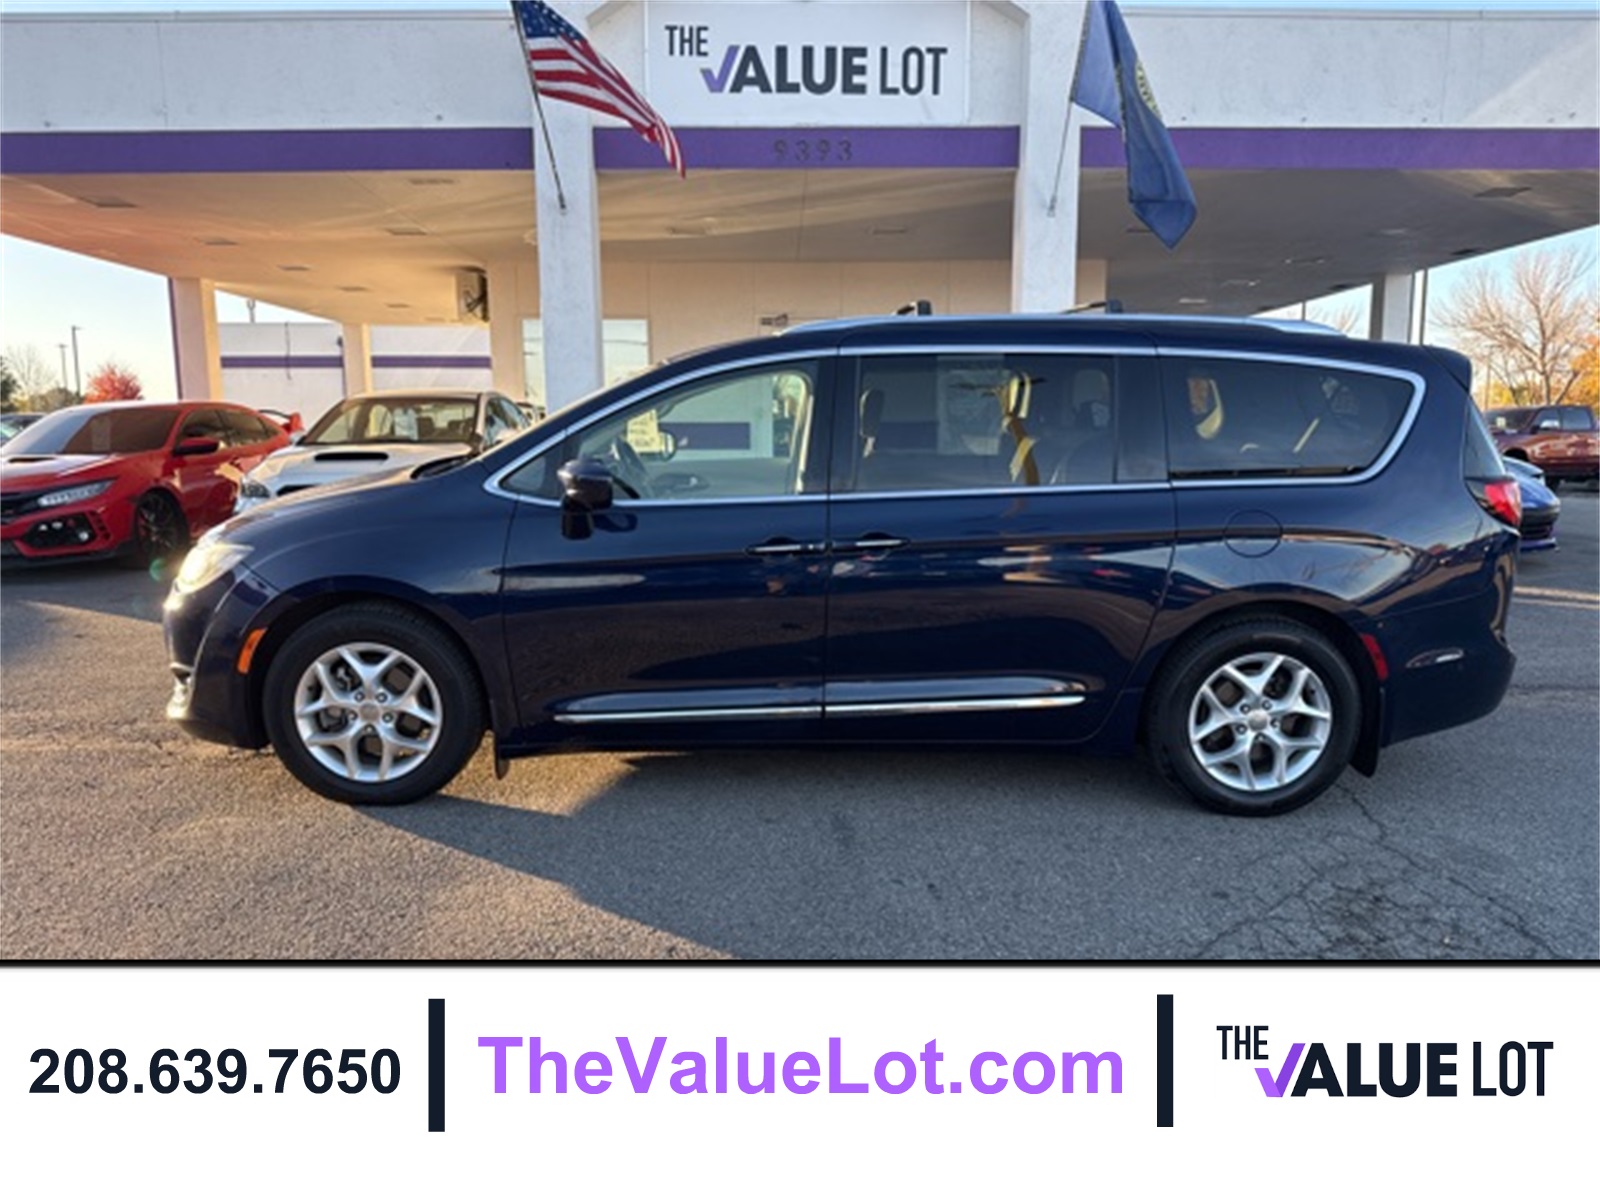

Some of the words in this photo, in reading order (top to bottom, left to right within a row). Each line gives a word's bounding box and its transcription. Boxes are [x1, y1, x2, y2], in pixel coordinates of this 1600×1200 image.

[665, 26, 708, 56] THE
[700, 45, 868, 95] VALUE
[880, 46, 948, 96] LOT
[773, 138, 853, 162] 9393
